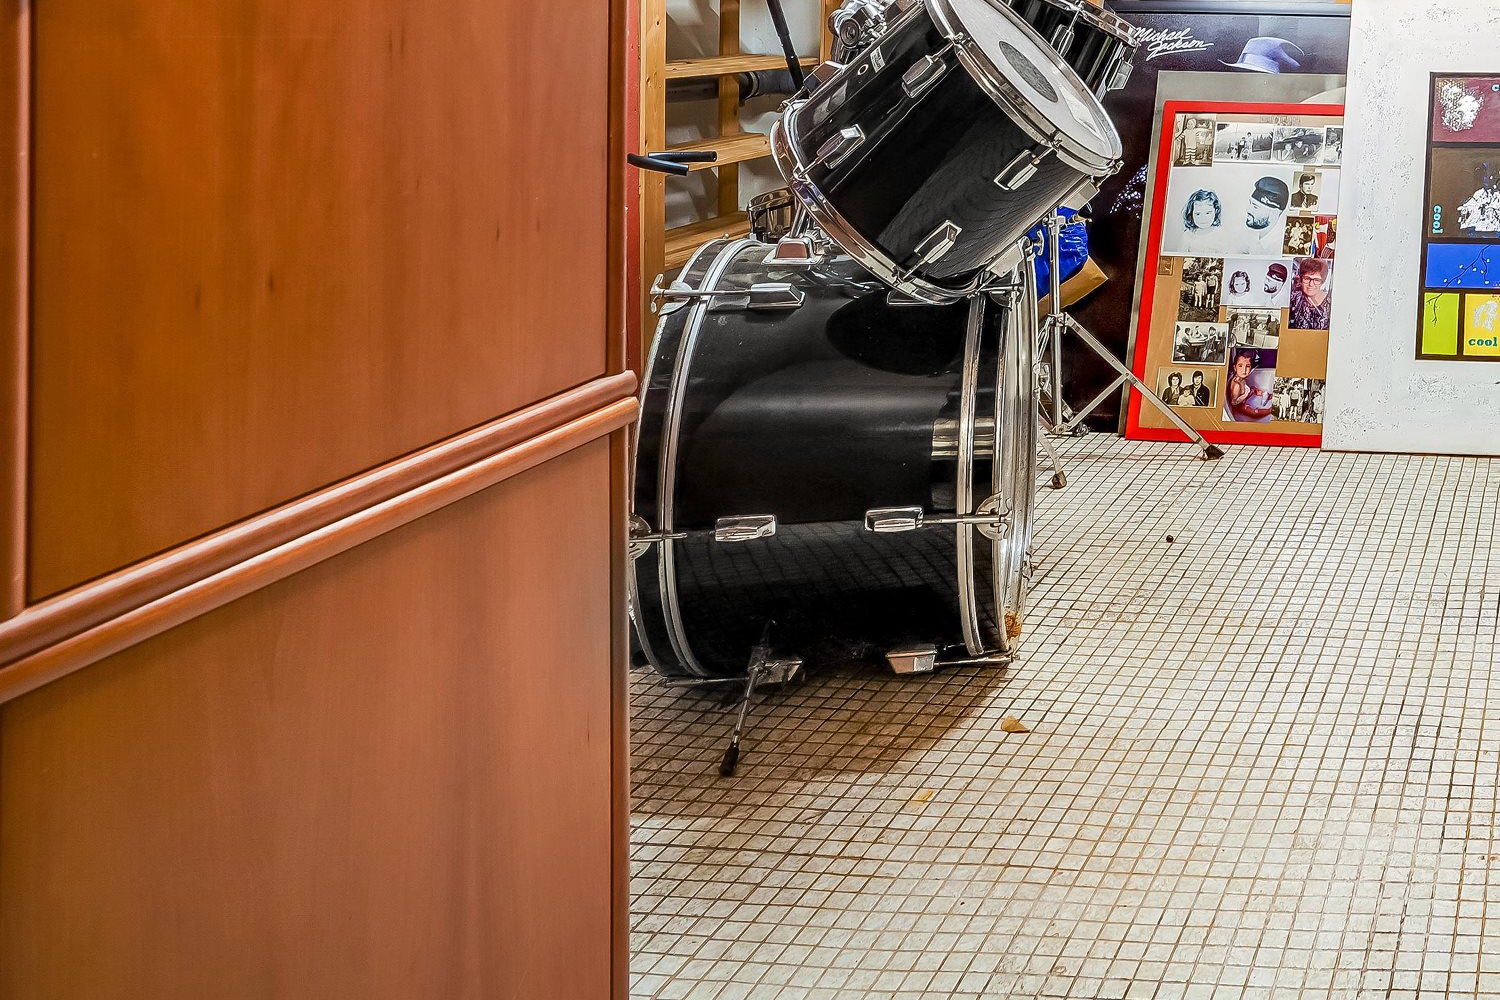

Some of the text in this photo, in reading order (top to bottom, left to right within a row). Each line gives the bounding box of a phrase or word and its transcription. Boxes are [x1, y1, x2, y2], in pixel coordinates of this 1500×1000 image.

[1133, 27, 1193, 42] Michael
[1146, 39, 1214, 61] Jackson
[1432, 205, 1444, 234] cool
[1468, 336, 1498, 347] cool
